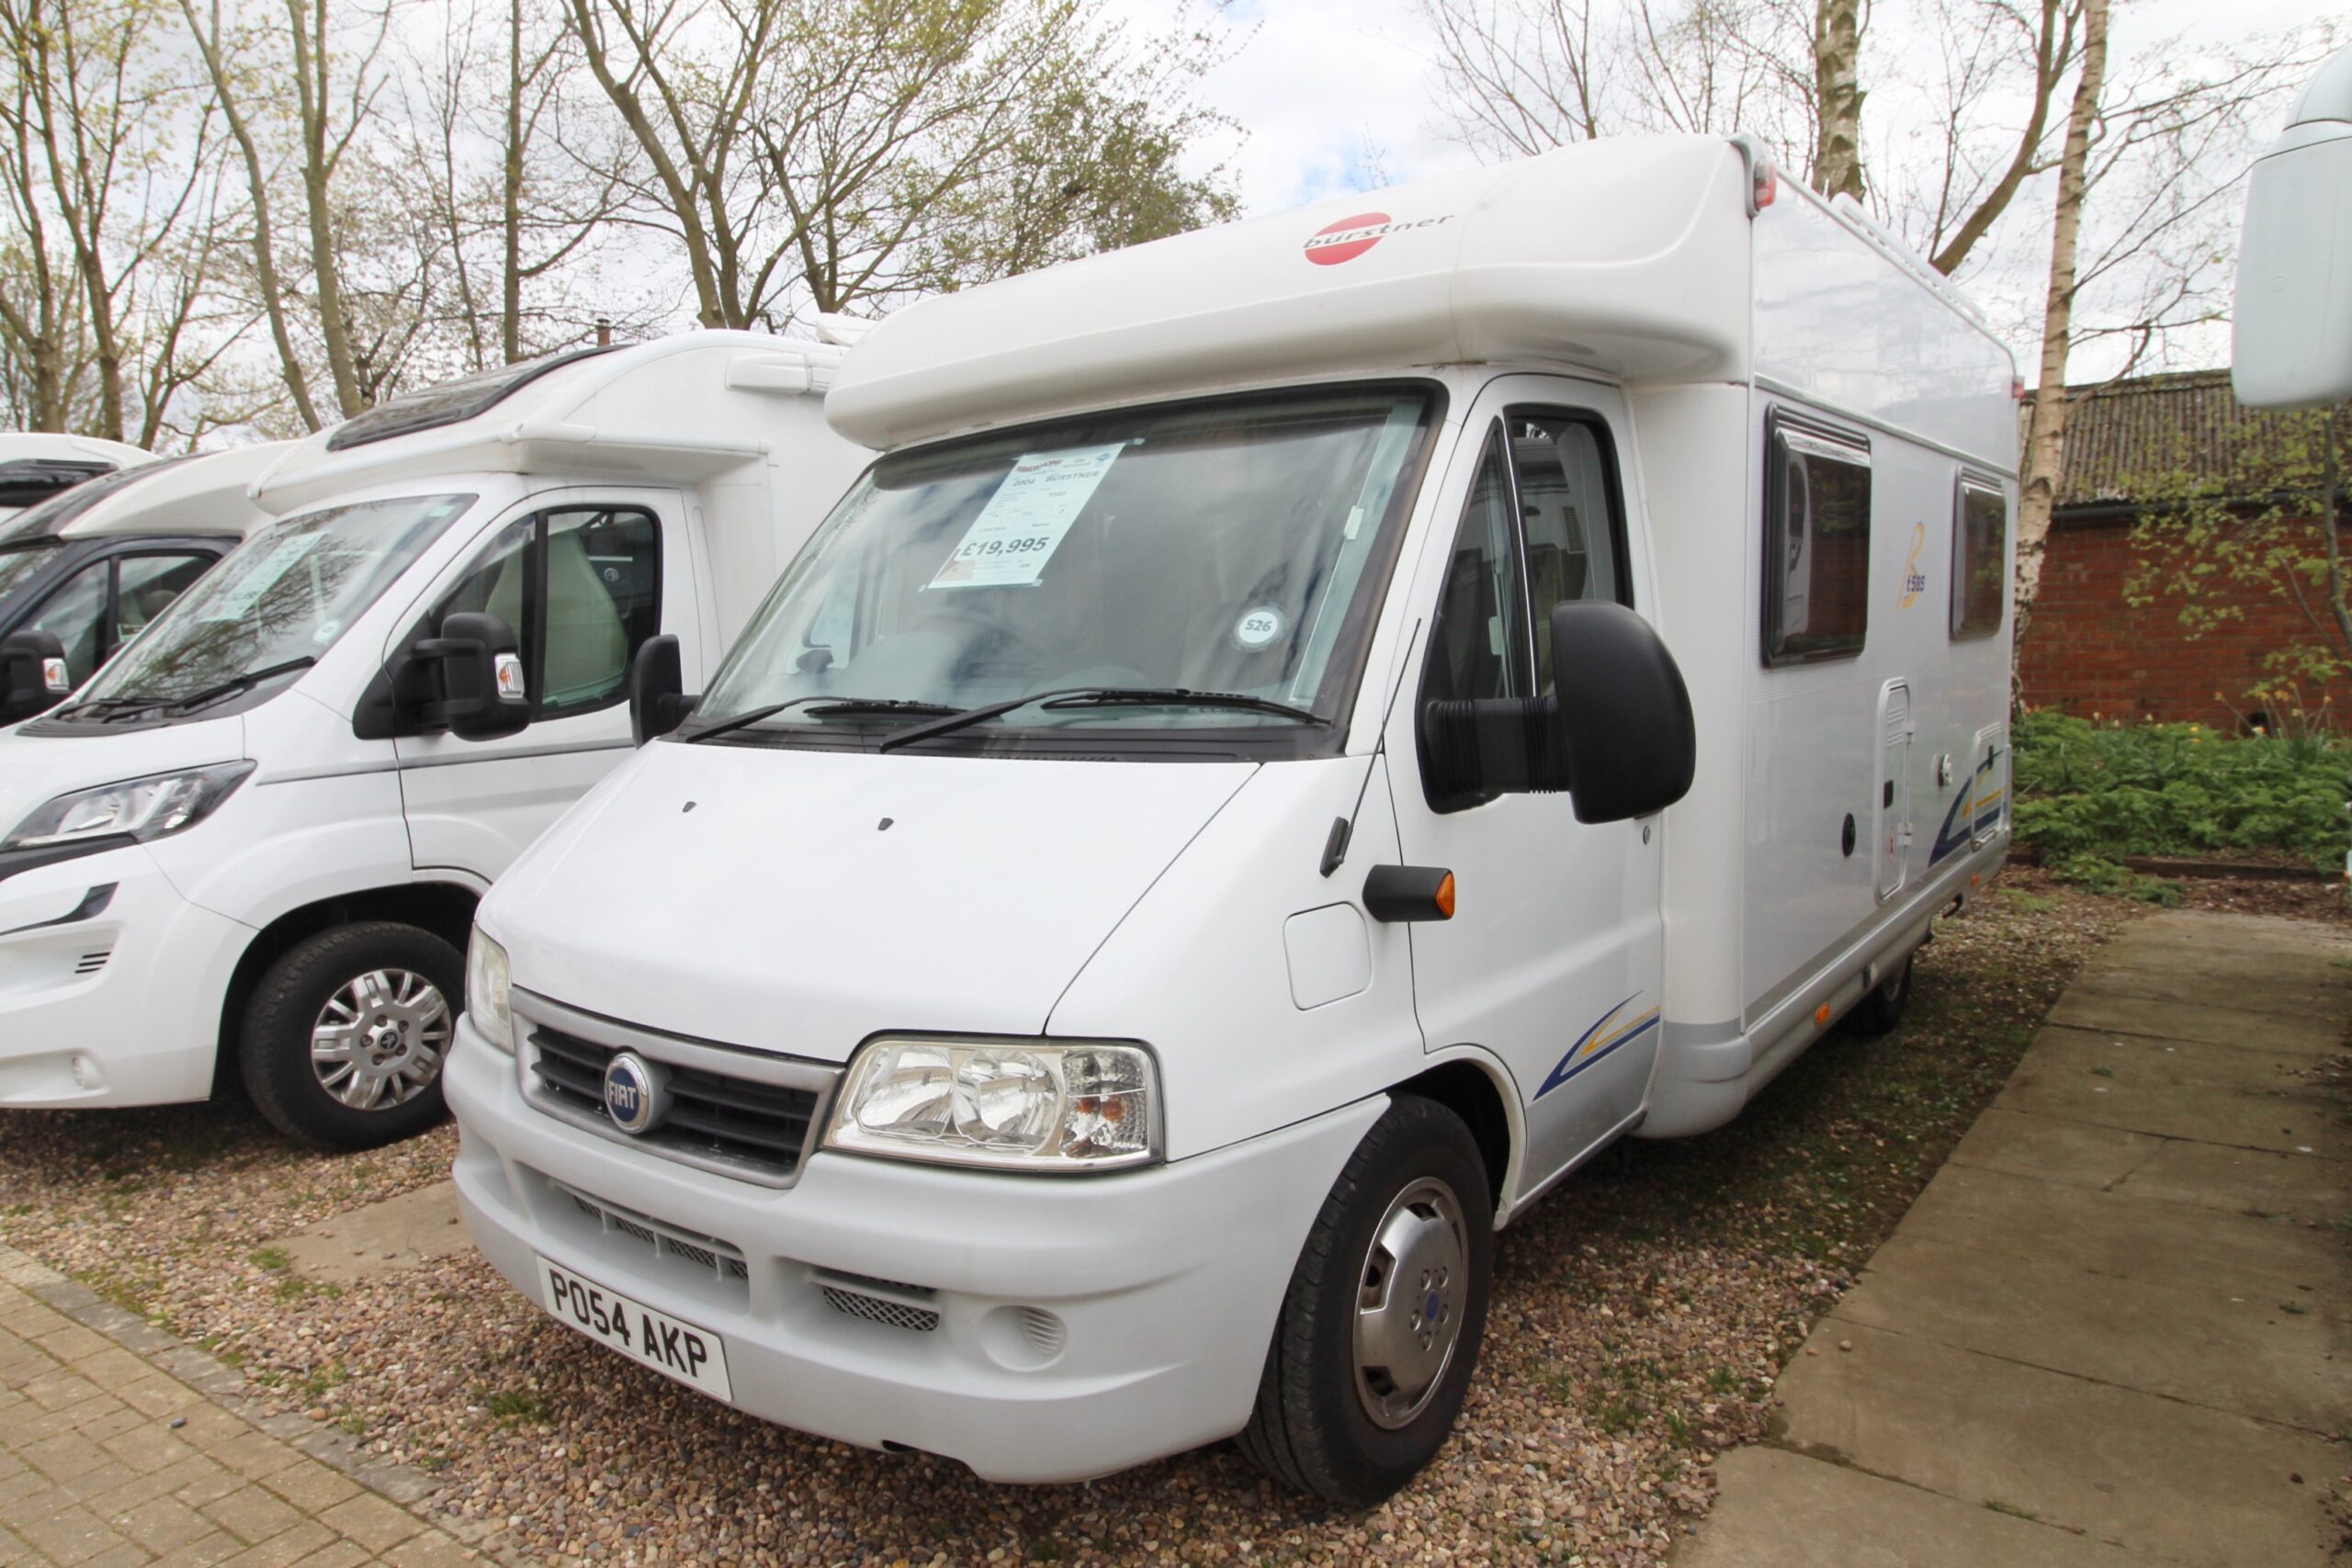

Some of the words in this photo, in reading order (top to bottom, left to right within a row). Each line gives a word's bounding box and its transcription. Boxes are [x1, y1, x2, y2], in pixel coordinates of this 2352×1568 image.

[960, 536, 1050, 558] £19,995
[1245, 619, 1272, 632] 526
[608, 1080, 637, 1110] FIAT
[549, 1269, 631, 1347] PO54
[642, 1314, 707, 1378] AKP
